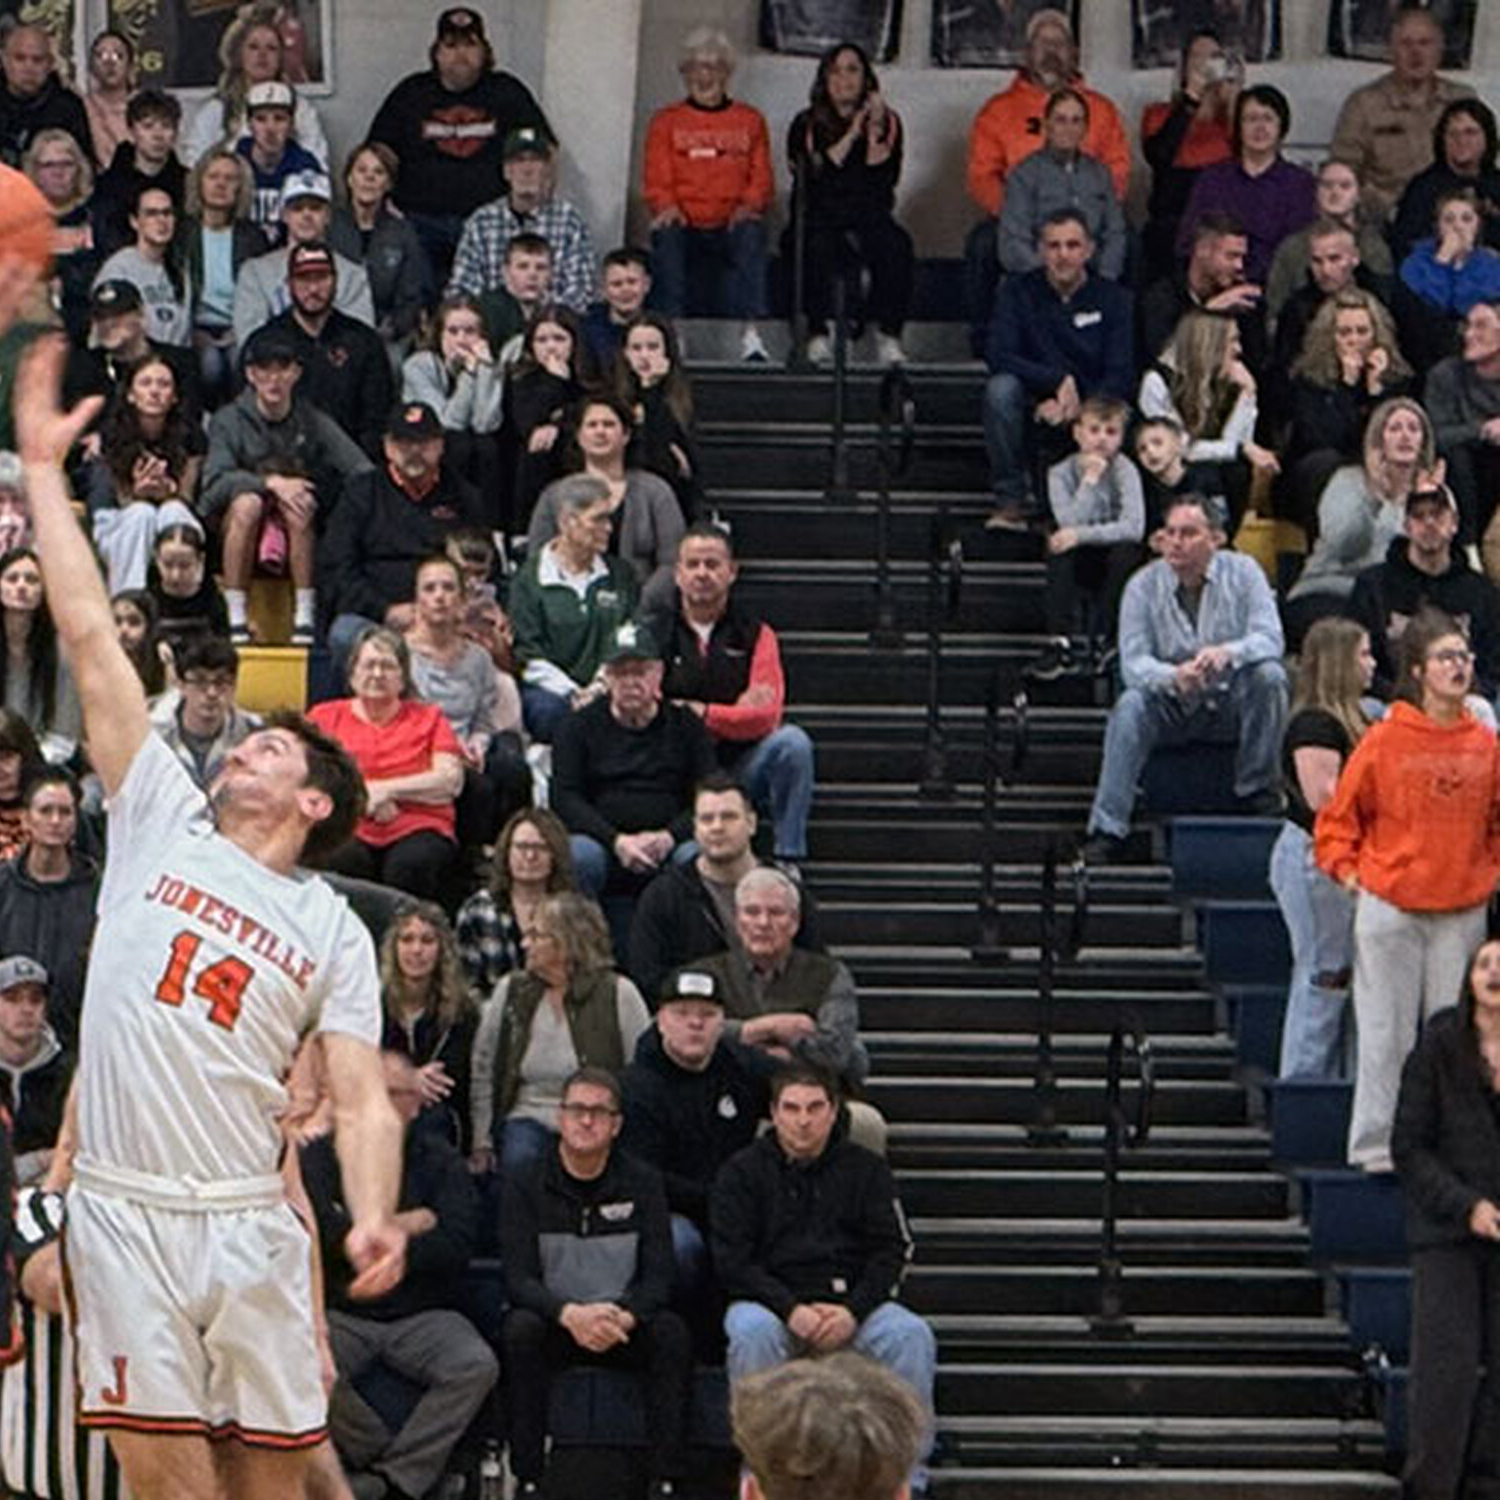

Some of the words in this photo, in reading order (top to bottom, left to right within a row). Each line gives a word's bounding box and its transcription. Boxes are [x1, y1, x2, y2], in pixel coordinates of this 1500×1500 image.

[145, 873, 316, 991] JONESVILLE
[155, 929, 255, 1032] 14
[102, 1355, 127, 1405] J
